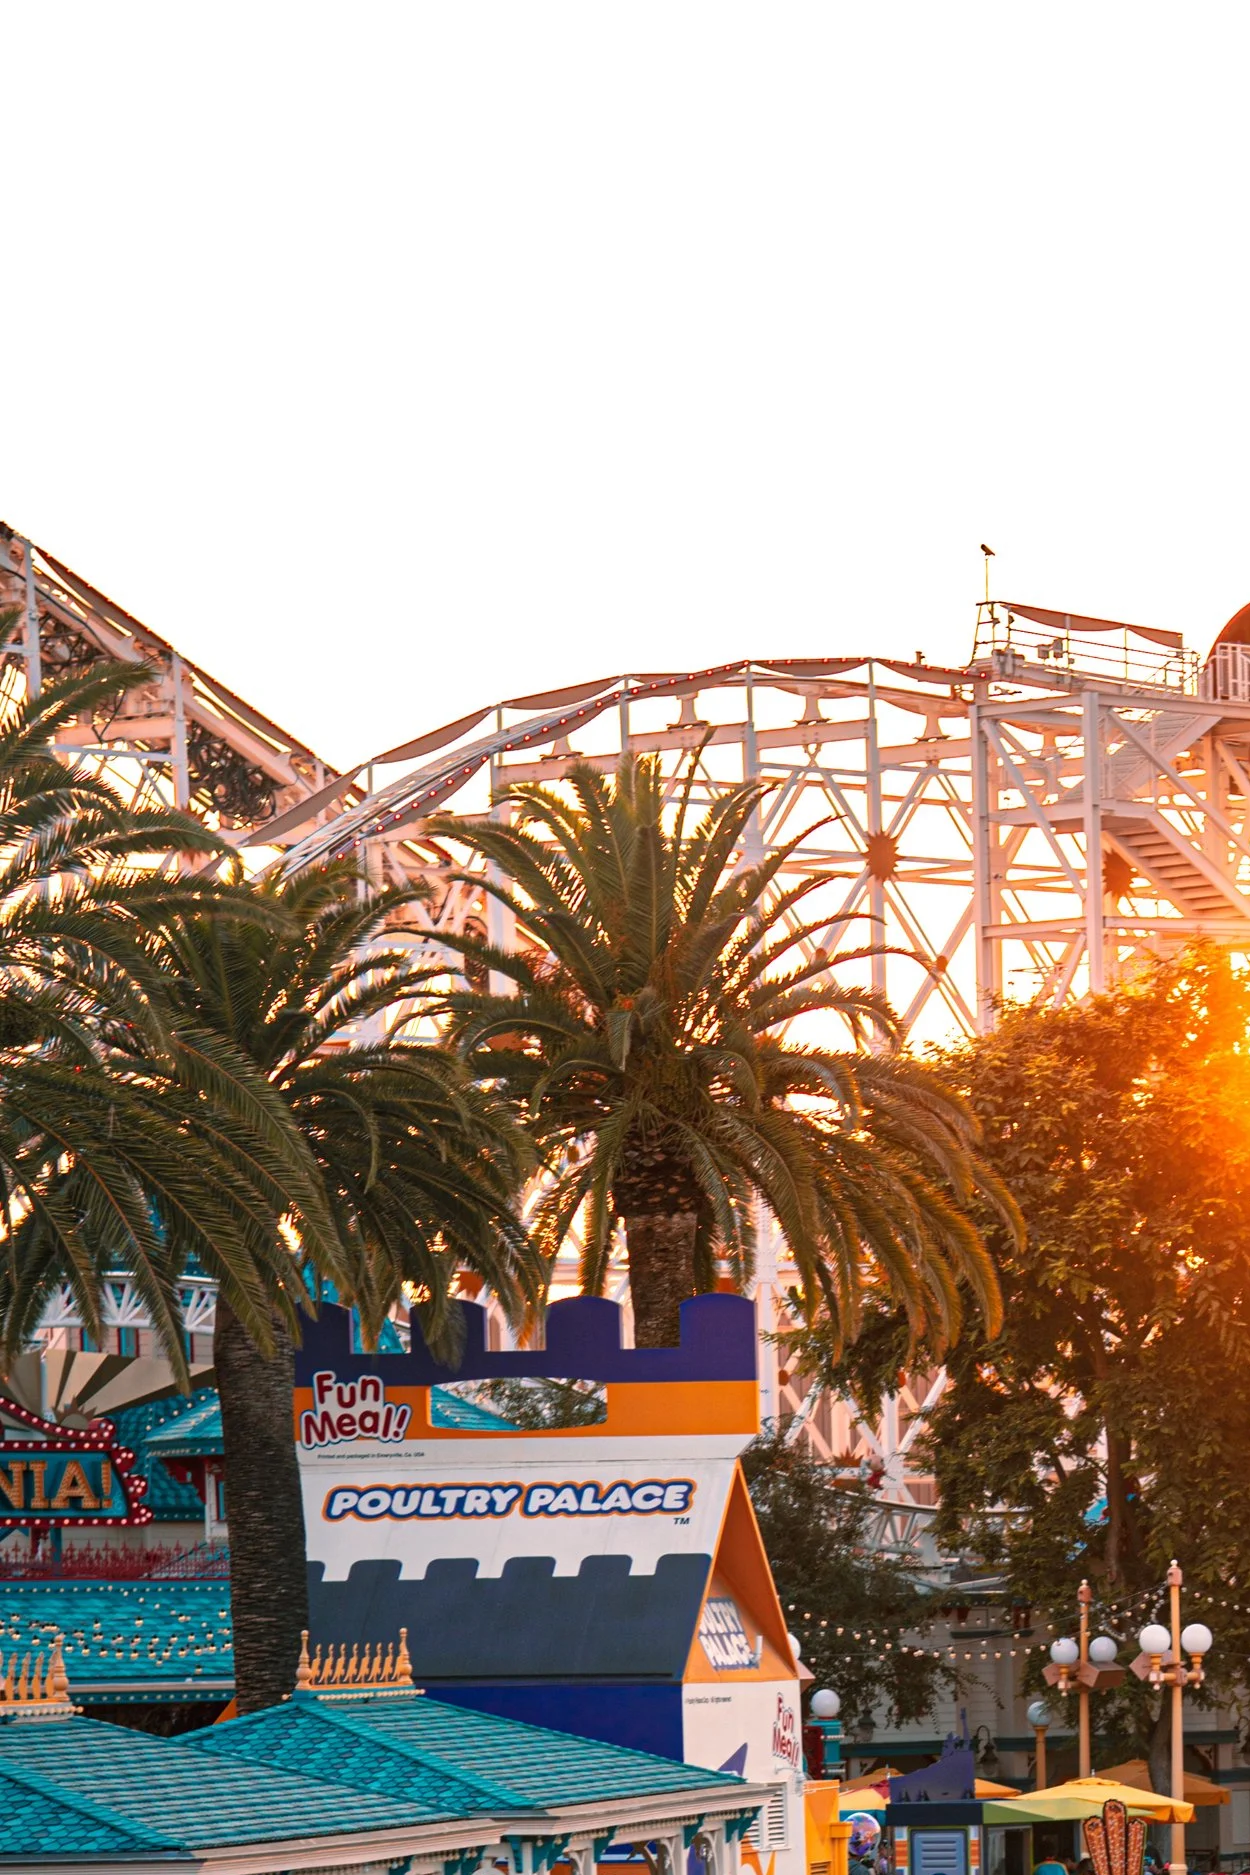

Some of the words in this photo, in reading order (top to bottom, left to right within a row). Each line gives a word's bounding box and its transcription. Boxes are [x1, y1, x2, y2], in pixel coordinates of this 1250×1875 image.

[315, 1373, 381, 1409] Fun
[303, 1406, 409, 1446] Meal!
[328, 1486, 520, 1518] POULTRY
[525, 1484, 690, 1515] PALACE
[673, 1518, 690, 1526] TM
